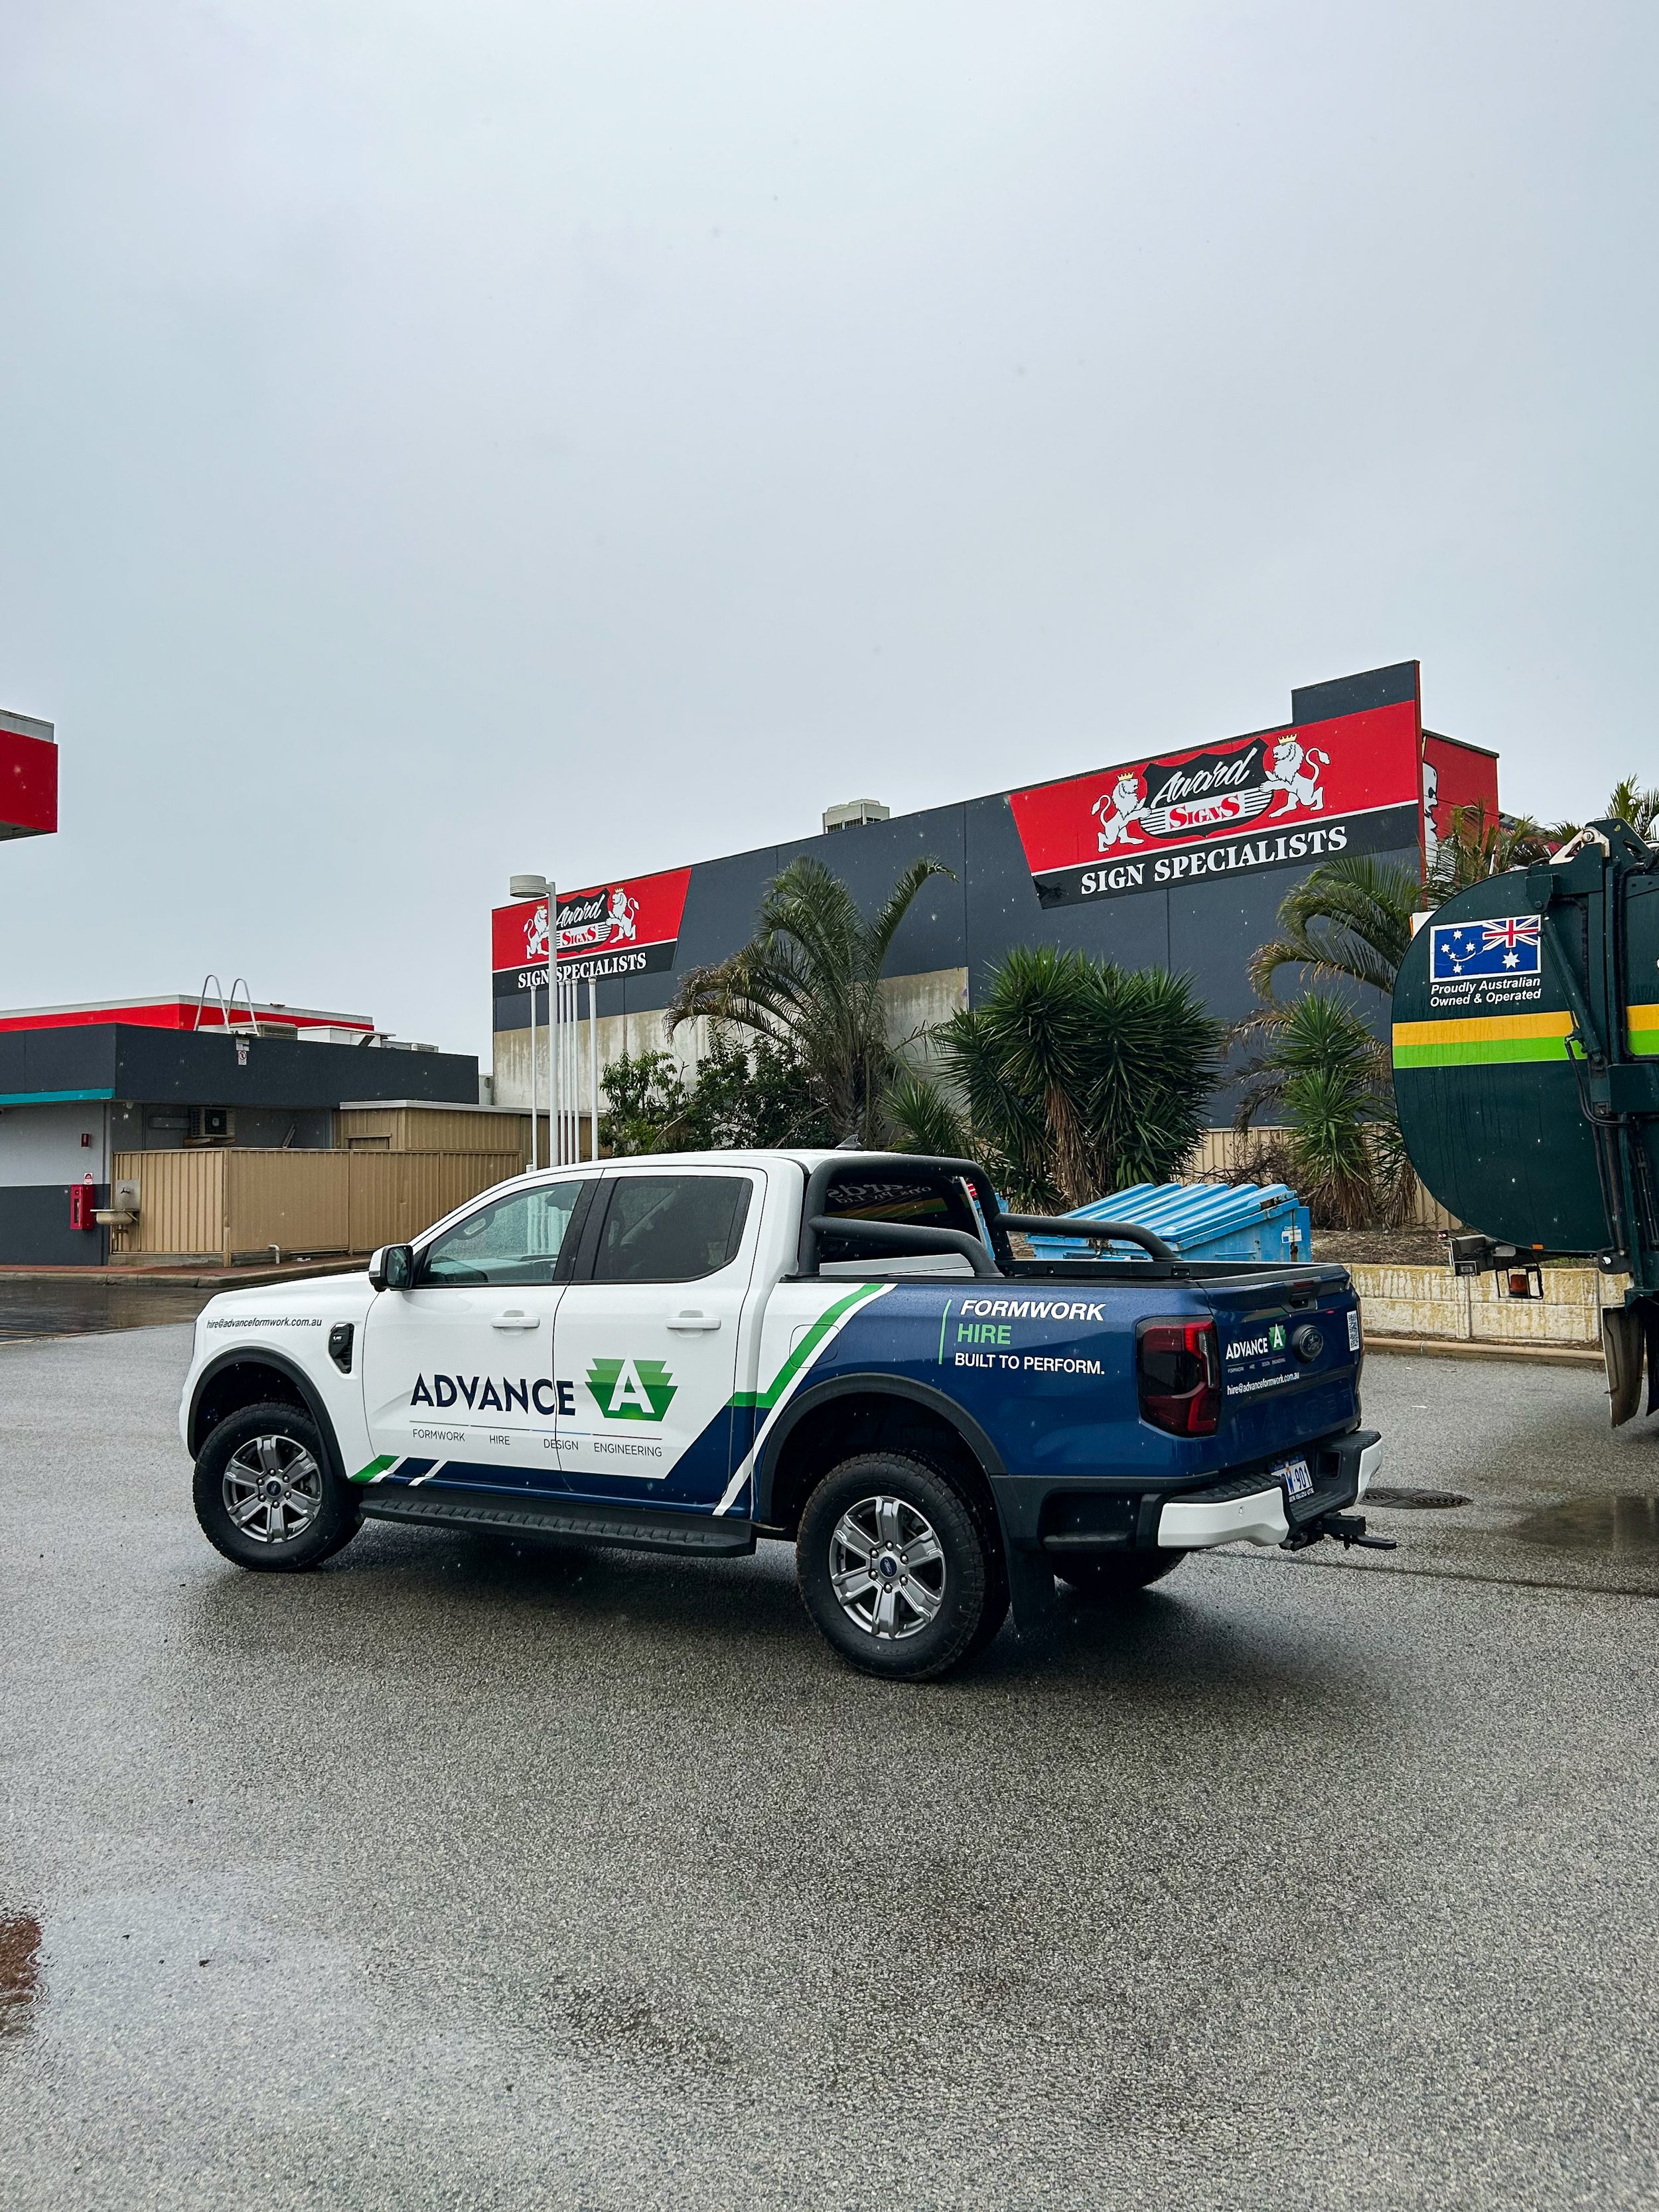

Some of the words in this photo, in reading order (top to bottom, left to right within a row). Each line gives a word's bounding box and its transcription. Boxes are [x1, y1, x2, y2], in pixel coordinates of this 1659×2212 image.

[1151, 748, 1258, 809] Award
[1080, 862, 1145, 895] SIGN
[1153, 825, 1348, 882] SPECIALISTS
[555, 894, 606, 928] Award
[518, 970, 549, 989] SIGN
[556, 952, 647, 981] SPECIALISTS
[1431, 982, 1477, 995] Proudly
[1479, 976, 1541, 991] Australian
[1430, 993, 1471, 1007] Owned
[1473, 994, 1482, 1003] &
[1486, 988, 1542, 1005] Operated
[960, 1299, 1106, 1321] FORMWORK
[206, 1317, 323, 1329] hire@advanceformwork.com.au
[958, 1323, 1012, 1345] HIRE
[1226, 1337, 1268, 1360] ADVANCE
[955, 1353, 995, 1368] BUILT
[999, 1355, 1019, 1369] TO
[1024, 1357, 1105, 1375] PERFORM.
[409, 1372, 576, 1416] ADVANCE
[412, 1428, 465, 1441] FORMWORK
[489, 1434, 510, 1445] HIRE
[543, 1438, 579, 1451] DESIGN
[594, 1442, 662, 1457] ENGINEERING
